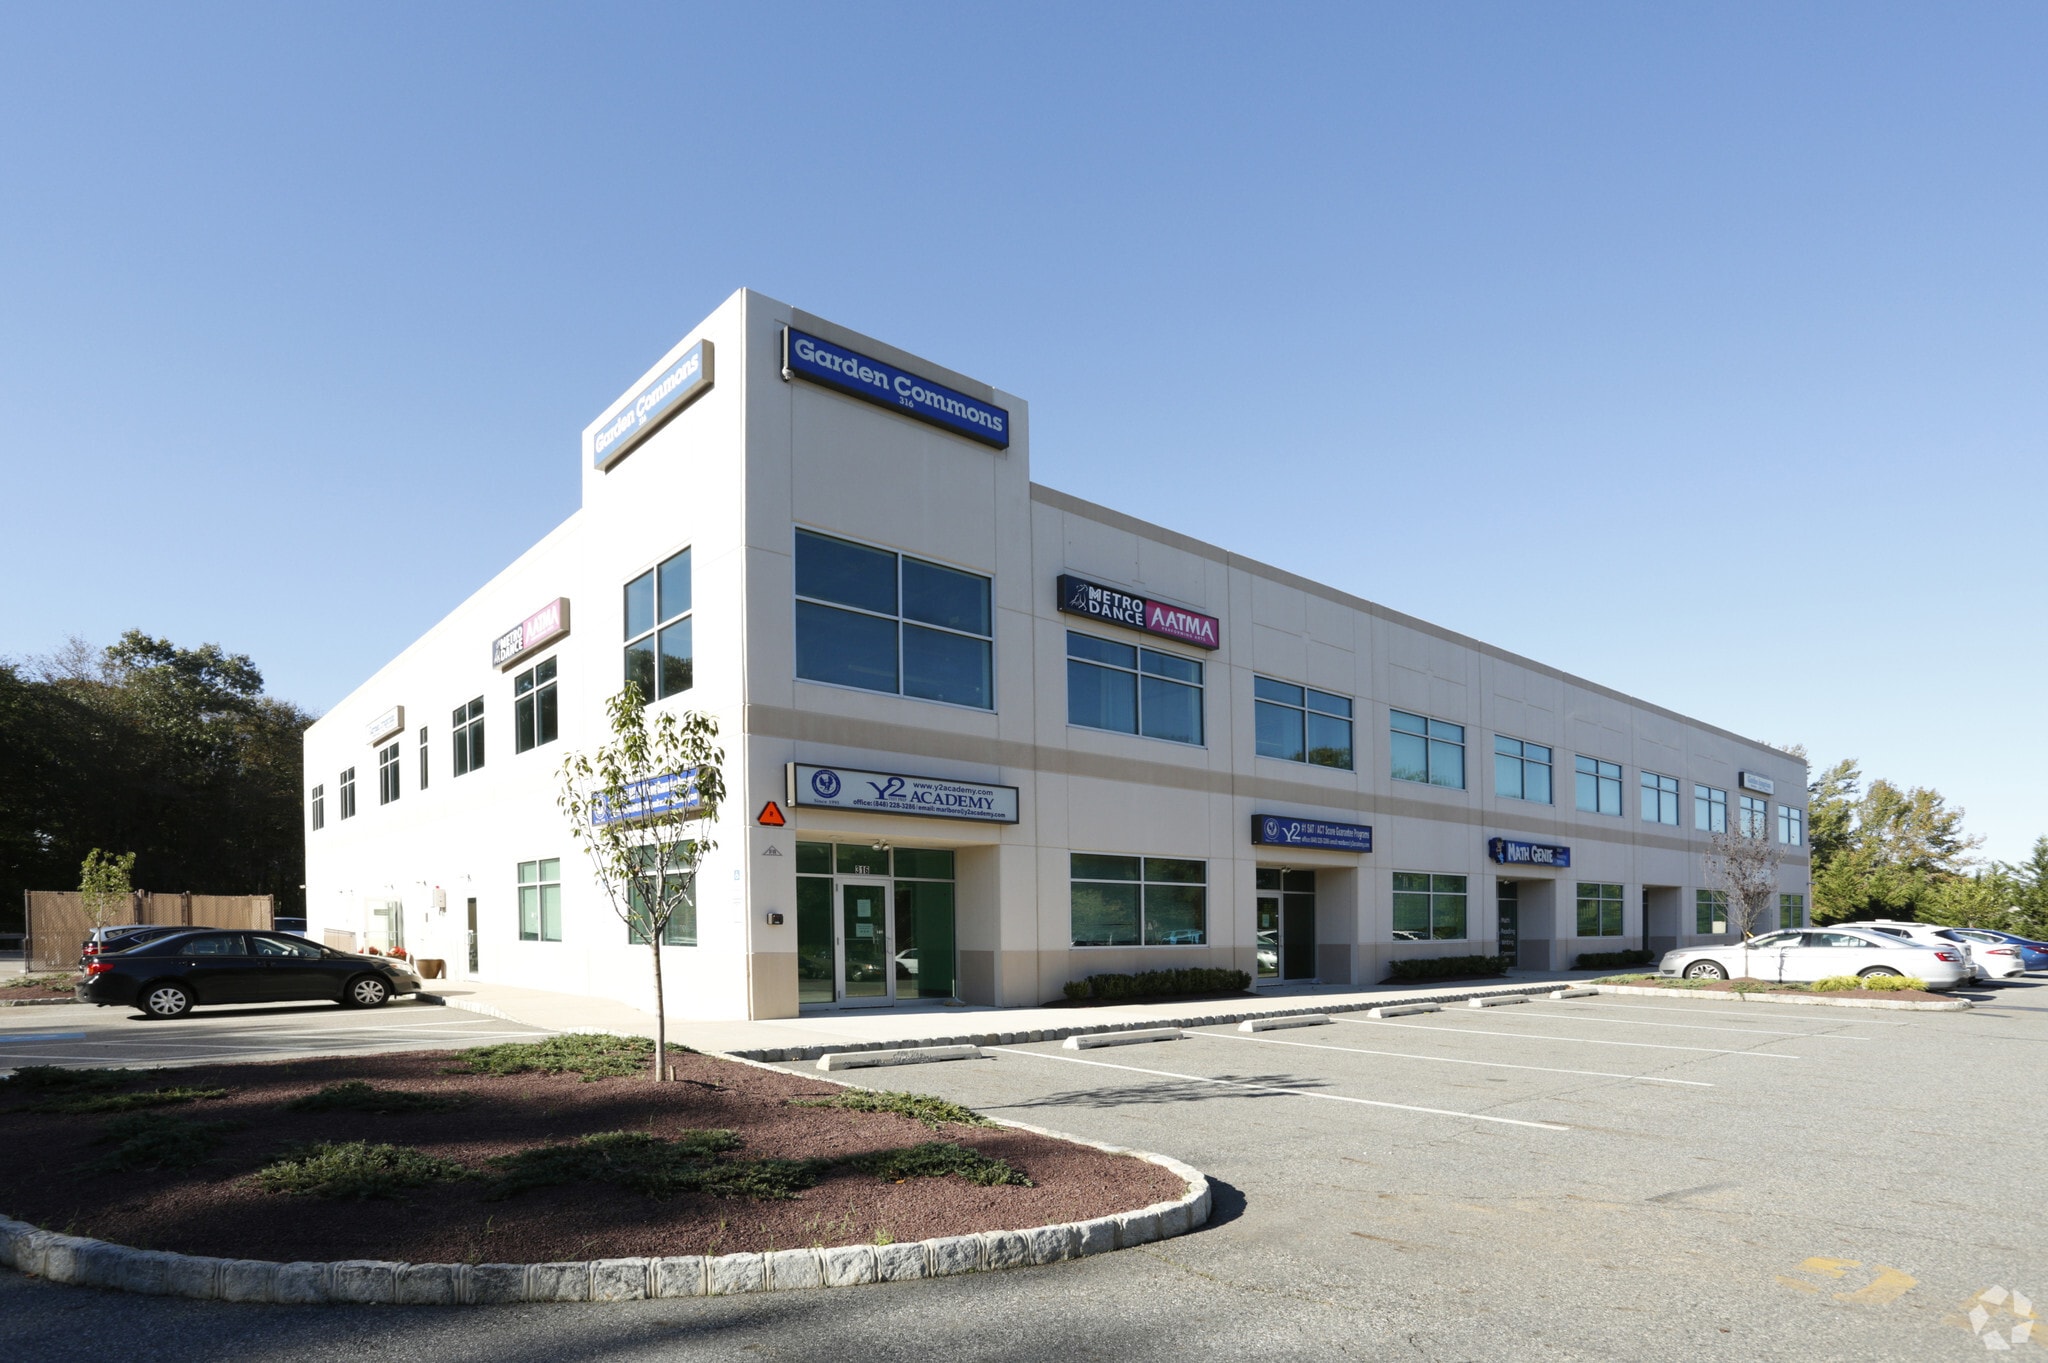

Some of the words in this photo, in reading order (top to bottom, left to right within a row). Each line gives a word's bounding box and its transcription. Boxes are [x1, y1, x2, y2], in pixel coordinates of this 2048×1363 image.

[795, 338, 889, 390] Garden
[893, 376, 1003, 432] Commons
[595, 410, 636, 453] Garden
[636, 353, 699, 418] Commons
[899, 396, 914, 409] 316
[1088, 586, 1143, 613] METRO
[1089, 600, 1144, 626] DANCE
[1151, 607, 1215, 643] AATMA
[500, 626, 523, 648] METRO
[500, 637, 524, 662] DANCE
[866, 776, 906, 801] Y2
[912, 782, 994, 796] www.y2academy.com
[853, 798, 873, 806] office:
[910, 790, 995, 810] ACADEMY
[1282, 822, 1301, 843] Y2
[1507, 843, 1530, 862] MATH
[1531, 845, 1554, 864] GENIE
[855, 865, 870, 875] 316
